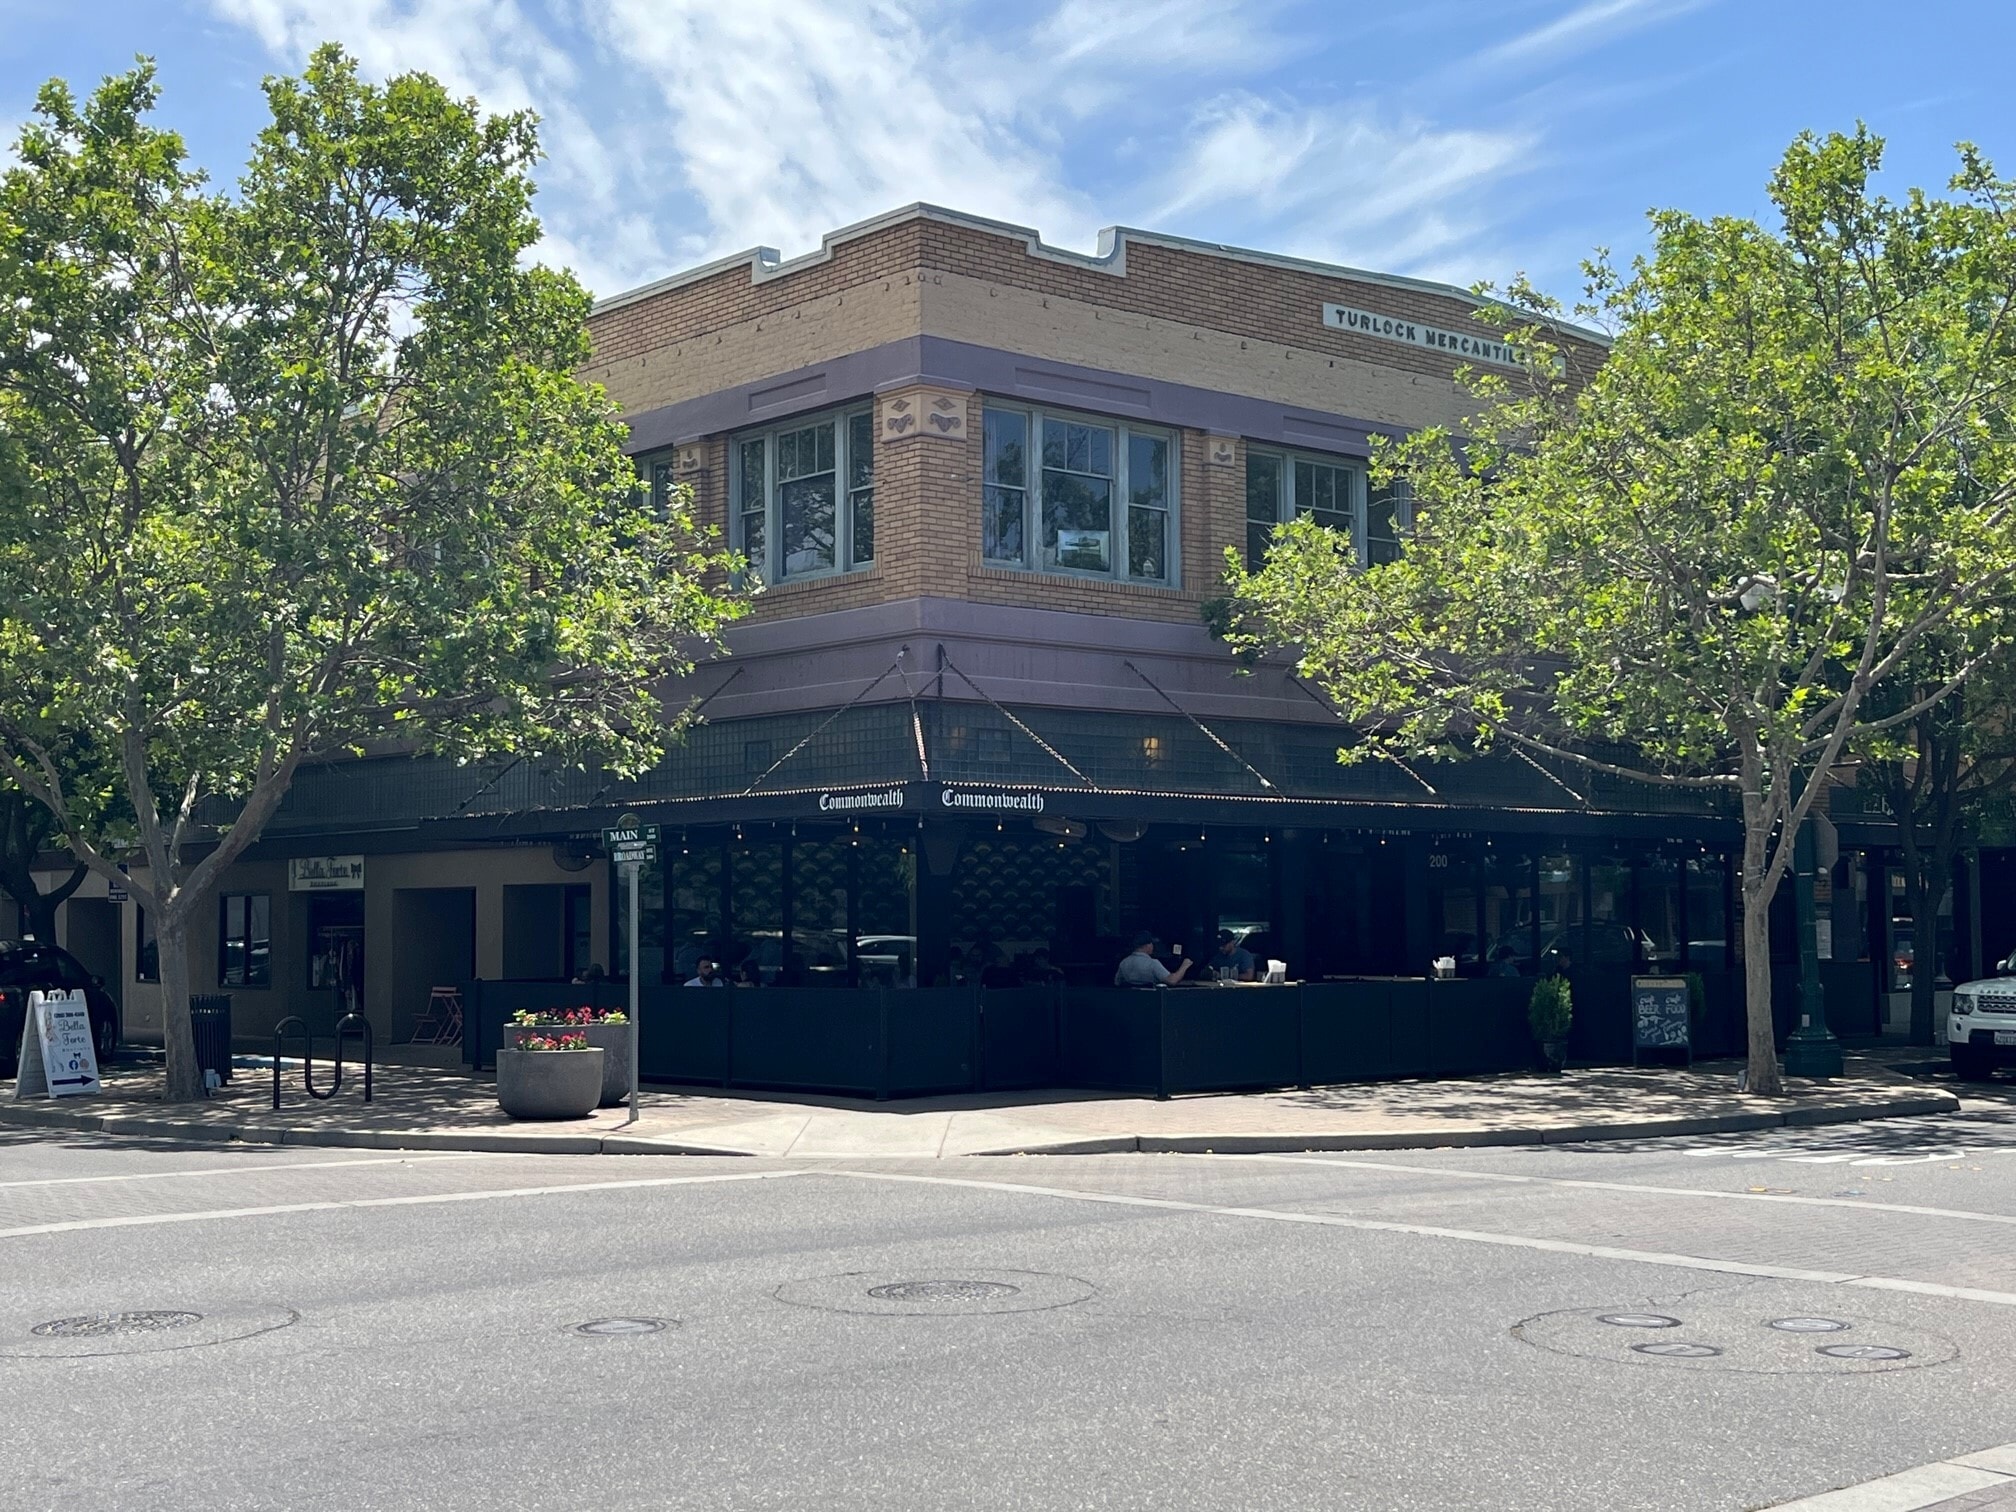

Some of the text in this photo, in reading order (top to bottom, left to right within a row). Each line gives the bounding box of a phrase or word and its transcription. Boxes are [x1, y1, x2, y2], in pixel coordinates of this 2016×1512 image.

[1335, 308, 1416, 341] TURLOCK
[819, 788, 904, 811] Commonwealth
[941, 788, 1044, 813] Commonwealth
[609, 829, 638, 842] MAIN
[1429, 854, 1448, 868] 200
[58, 1019, 86, 1032] Bella
[62, 1032, 86, 1046] Forte
